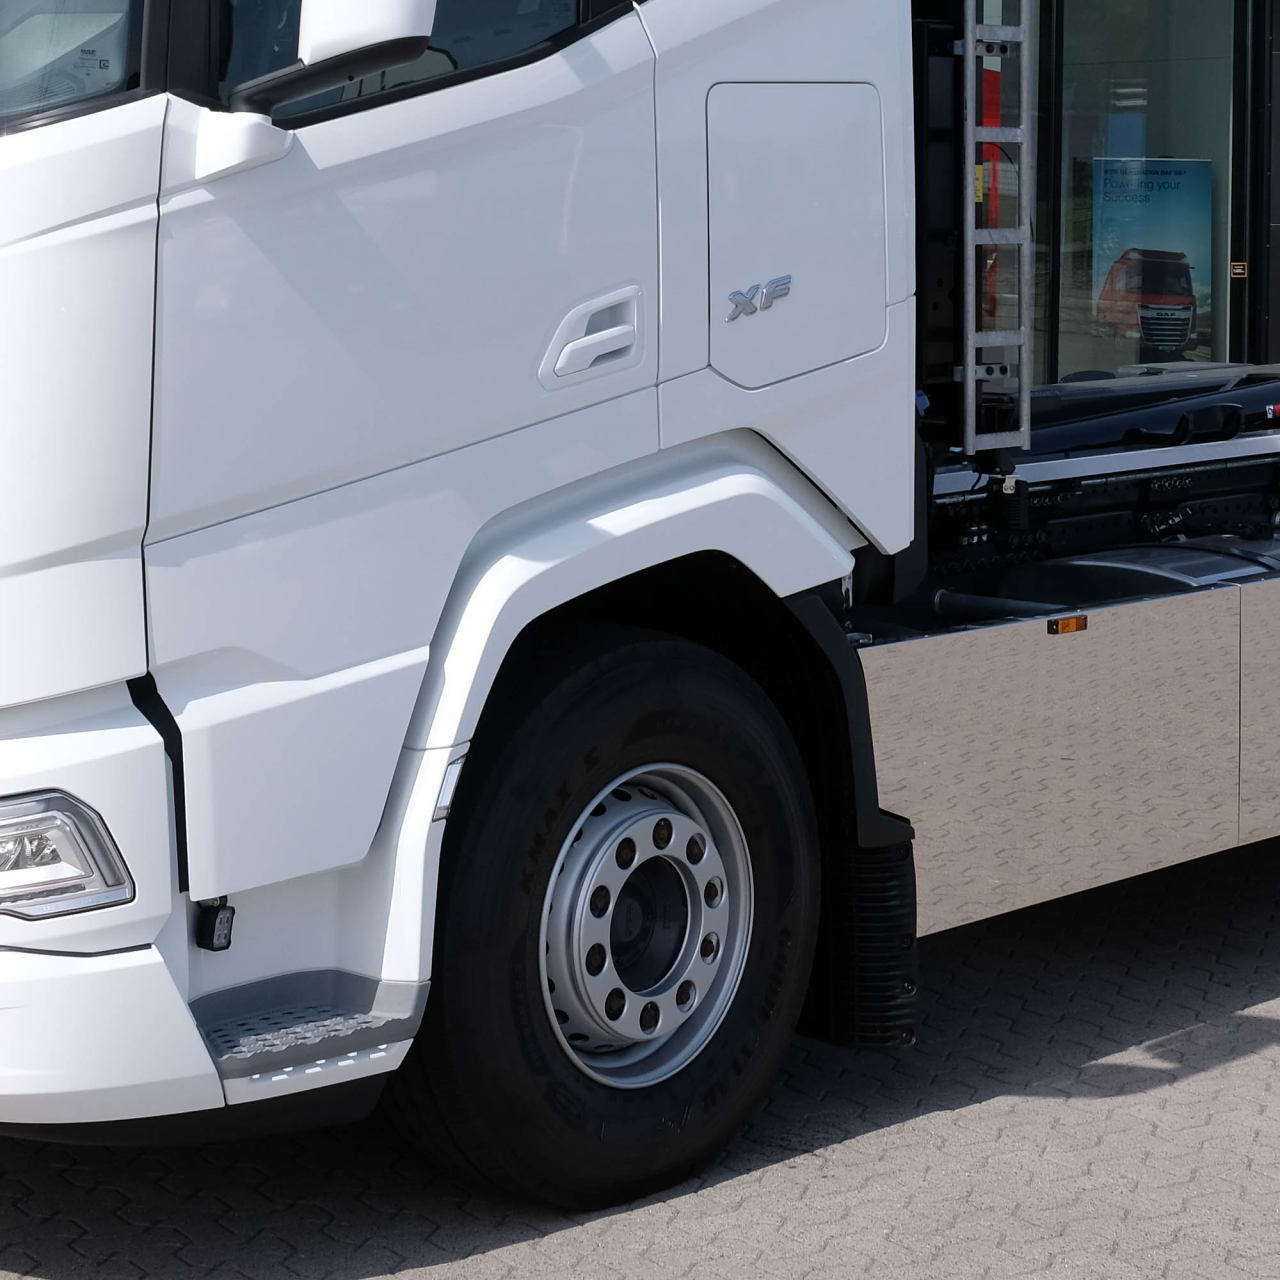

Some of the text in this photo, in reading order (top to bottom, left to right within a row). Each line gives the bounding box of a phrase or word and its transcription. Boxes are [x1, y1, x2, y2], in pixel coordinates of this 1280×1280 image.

[1104, 178, 1181, 193] Powing your
[724, 274, 792, 323] XF
